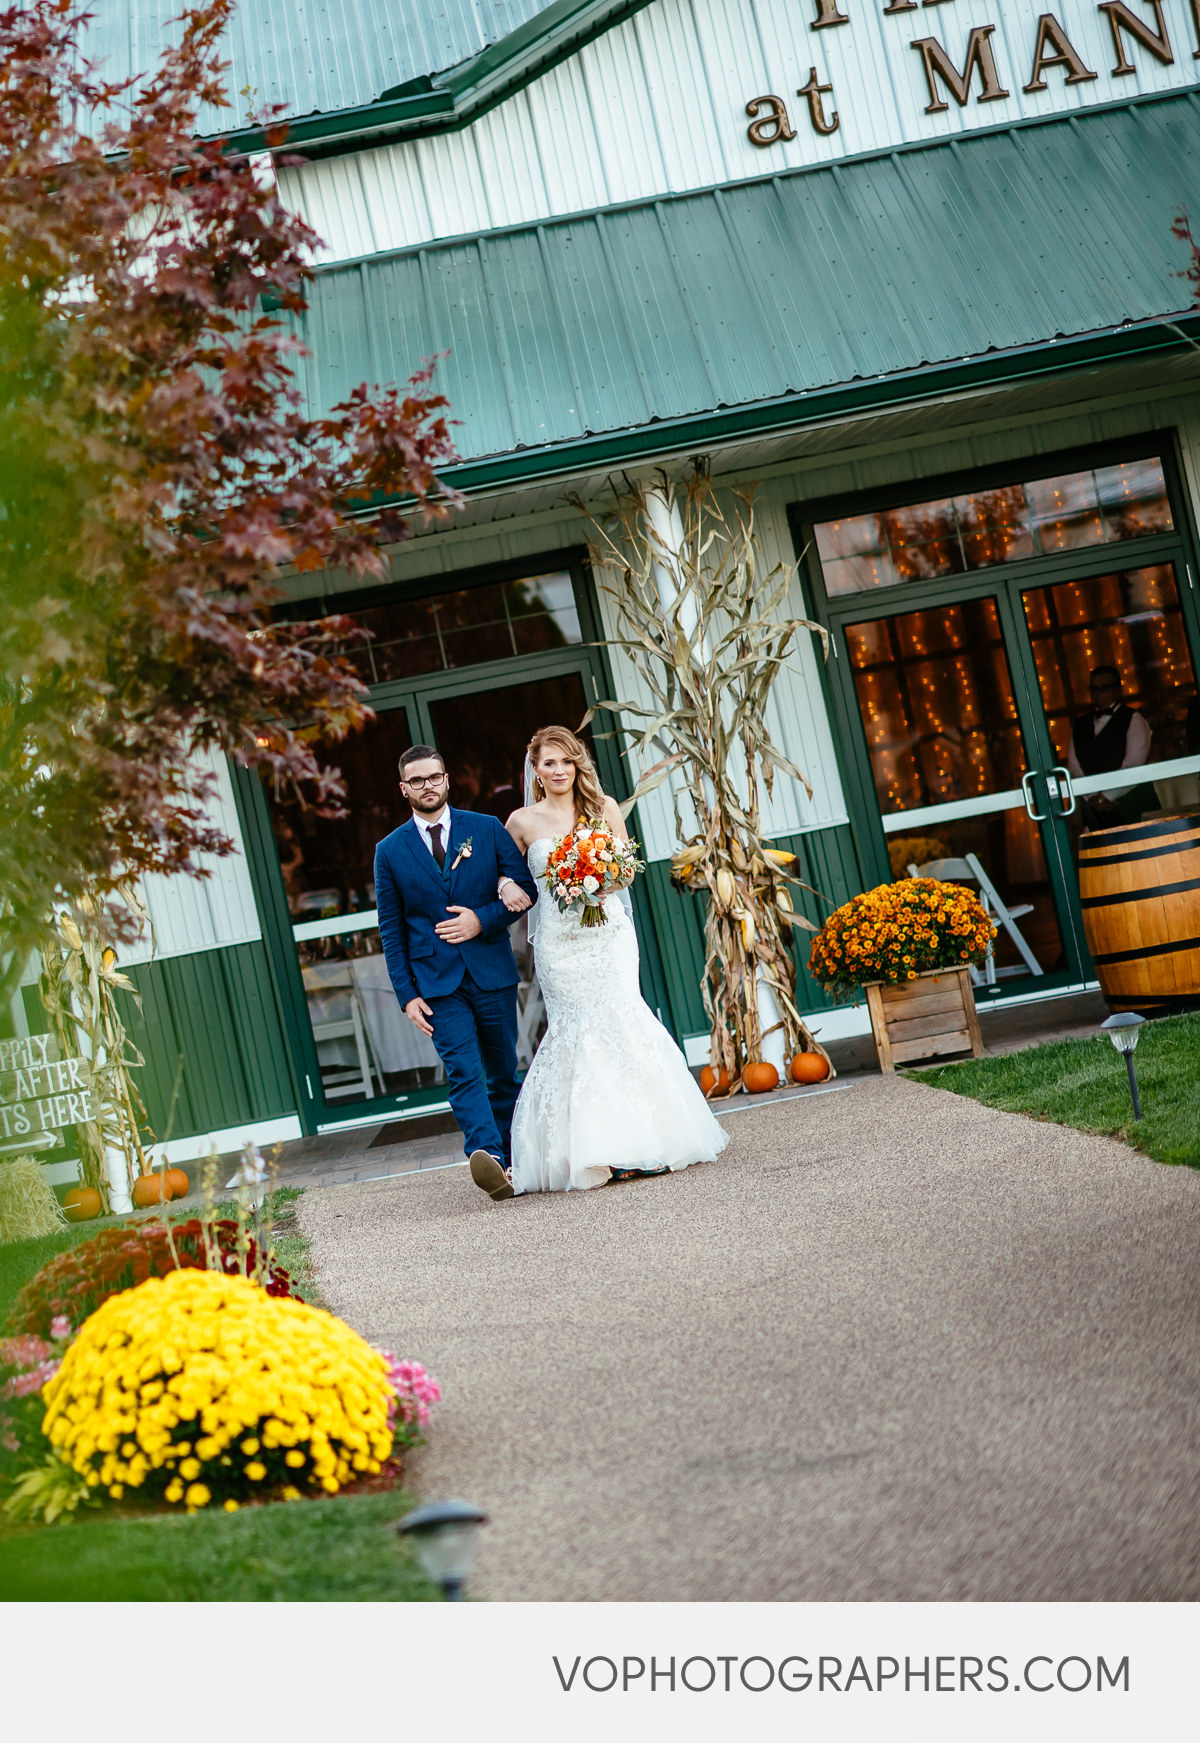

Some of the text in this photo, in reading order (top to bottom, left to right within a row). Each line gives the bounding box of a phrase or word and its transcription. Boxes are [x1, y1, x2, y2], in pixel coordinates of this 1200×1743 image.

[745, 0, 1200, 147] at MAN
[15, 1059, 88, 1101] AFTER
[36, 1090, 97, 1131] HERE
